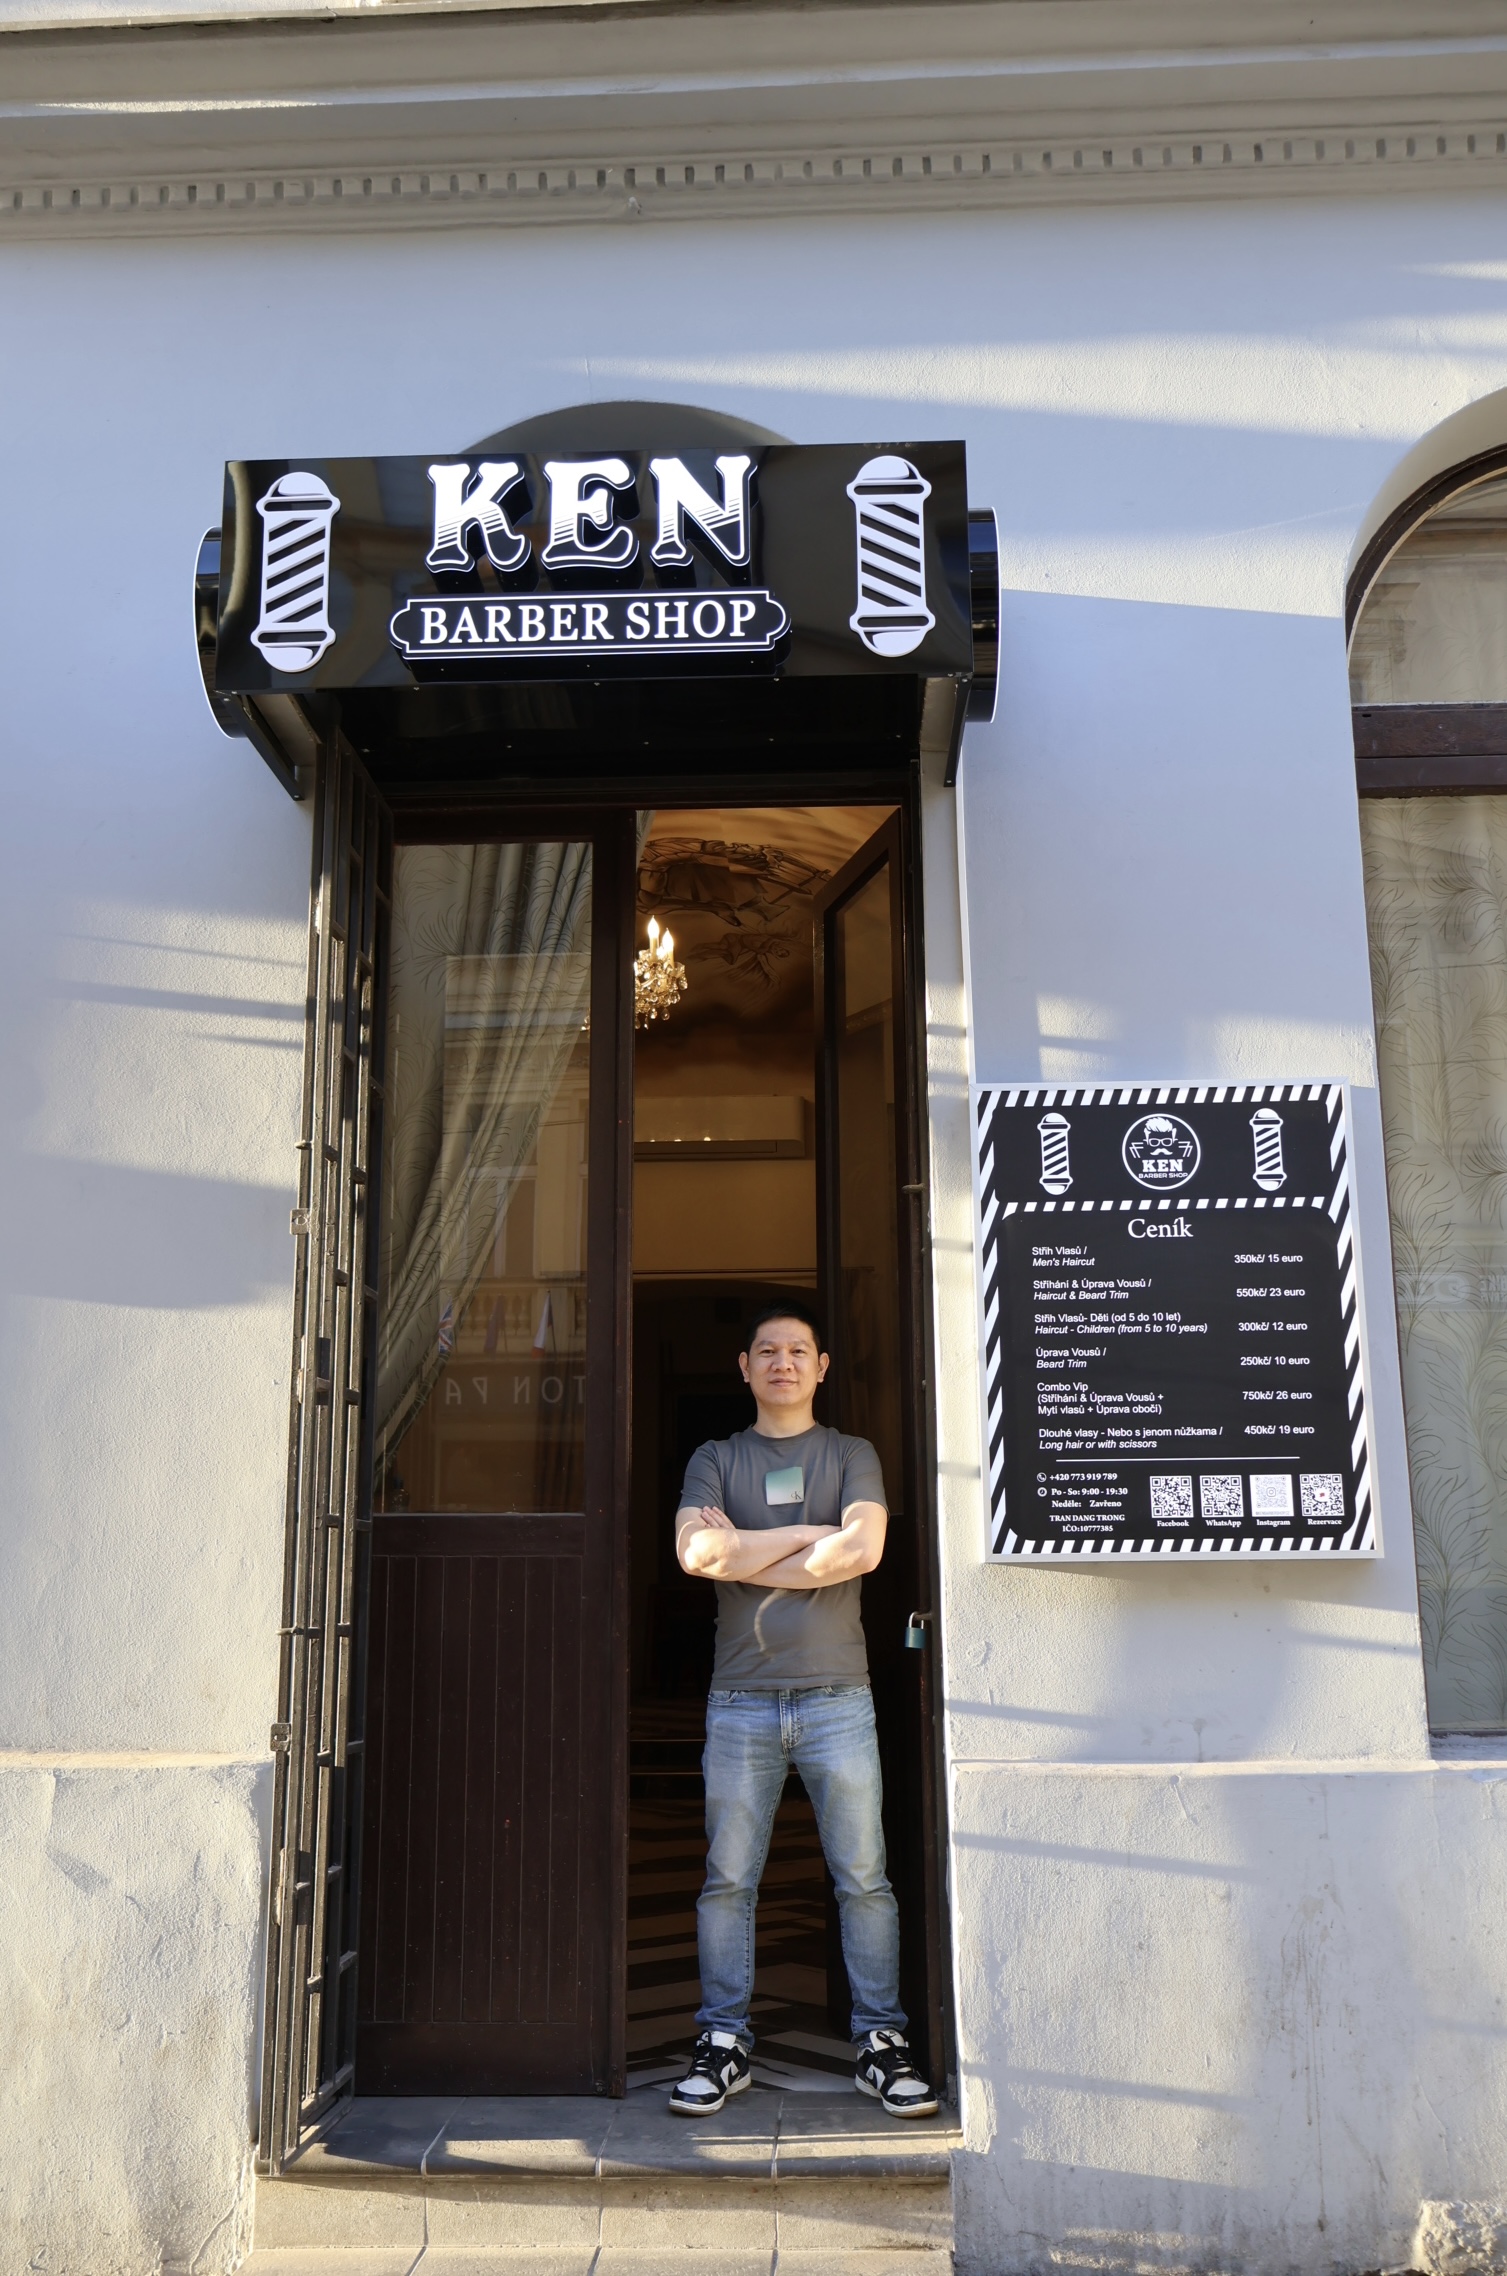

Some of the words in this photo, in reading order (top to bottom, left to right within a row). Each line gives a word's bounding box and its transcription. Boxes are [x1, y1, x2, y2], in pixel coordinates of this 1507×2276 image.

[424, 454, 760, 573] KEN
[420, 603, 616, 645] BARBER
[626, 599, 756, 639] SHOP
[1142, 1159, 1183, 1172] KEN
[1128, 1217, 1193, 1238] Ceník
[1032, 1247, 1053, 1255] Střih
[1055, 1246, 1081, 1255] Vlasů
[1033, 1258, 1059, 1266] Men's
[1062, 1258, 1095, 1266] Haircut
[1234, 1254, 1265, 1263] 350kč/
[1268, 1254, 1279, 1262] 15
[1072, 1280, 1079, 1288] &
[1082, 1278, 1115, 1290] Úprava
[1117, 1279, 1146, 1287] Vousů
[1034, 1292, 1067, 1300] Haircut
[1069, 1291, 1076, 1299] &
[1079, 1291, 1106, 1299] Beard
[1109, 1291, 1129, 1299] Trim
[1237, 1288, 1267, 1297] 550kč/
[1270, 1288, 1281, 1296] 23
[1035, 1314, 1055, 1323] Střih
[1058, 1313, 1087, 1322] Vlasů-
[1090, 1313, 1108, 1322] Děti
[1111, 1313, 1126, 1323] (od
[1129, 1313, 1135, 1321] 5
[1137, 1313, 1149, 1321] do
[1153, 1313, 1163, 1321] 10
[1166, 1312, 1181, 1322] let)
[1035, 1326, 1068, 1334] Haircut
[1077, 1325, 1115, 1333] Children
[1118, 1324, 1142, 1335] (from
[1145, 1324, 1151, 1332] 5
[1153, 1324, 1162, 1332] to
[1165, 1324, 1176, 1332] 10
[1179, 1323, 1207, 1334] years)
[1239, 1322, 1269, 1331] 300kč/
[1272, 1322, 1284, 1330] 12
[1036, 1347, 1069, 1358] Úprava
[1071, 1347, 1100, 1356] Vousů
[1037, 1360, 1064, 1368] Beard
[1067, 1359, 1087, 1367] Trim
[1241, 1356, 1271, 1365] 250kč/
[1275, 1356, 1286, 1365] 10
[1037, 1383, 1071, 1391] Combo
[1073, 1382, 1088, 1392] Vip
[1080, 1394, 1087, 1402] &
[1090, 1392, 1123, 1404] Úprava
[1126, 1392, 1155, 1401] Vousů
[1243, 1391, 1274, 1400] 750kč/
[1276, 1391, 1288, 1399] 26
[1060, 1405, 1084, 1414] vlasů
[1096, 1402, 1130, 1415] Úprava
[1039, 1429, 1072, 1437] Dlouhé
[1074, 1429, 1098, 1439] vlasy
[1108, 1428, 1132, 1436] Nebo
[1143, 1428, 1172, 1438] jenom
[1175, 1427, 1217, 1435] nůžkama
[1244, 1425, 1276, 1434] 450kč/
[1279, 1425, 1290, 1434] 19
[1040, 1441, 1063, 1451] Long
[1065, 1440, 1084, 1448] hair
[1098, 1440, 1116, 1448] with
[1119, 1439, 1157, 1448] scissors
[1257, 1519, 1290, 1527] Instagram
